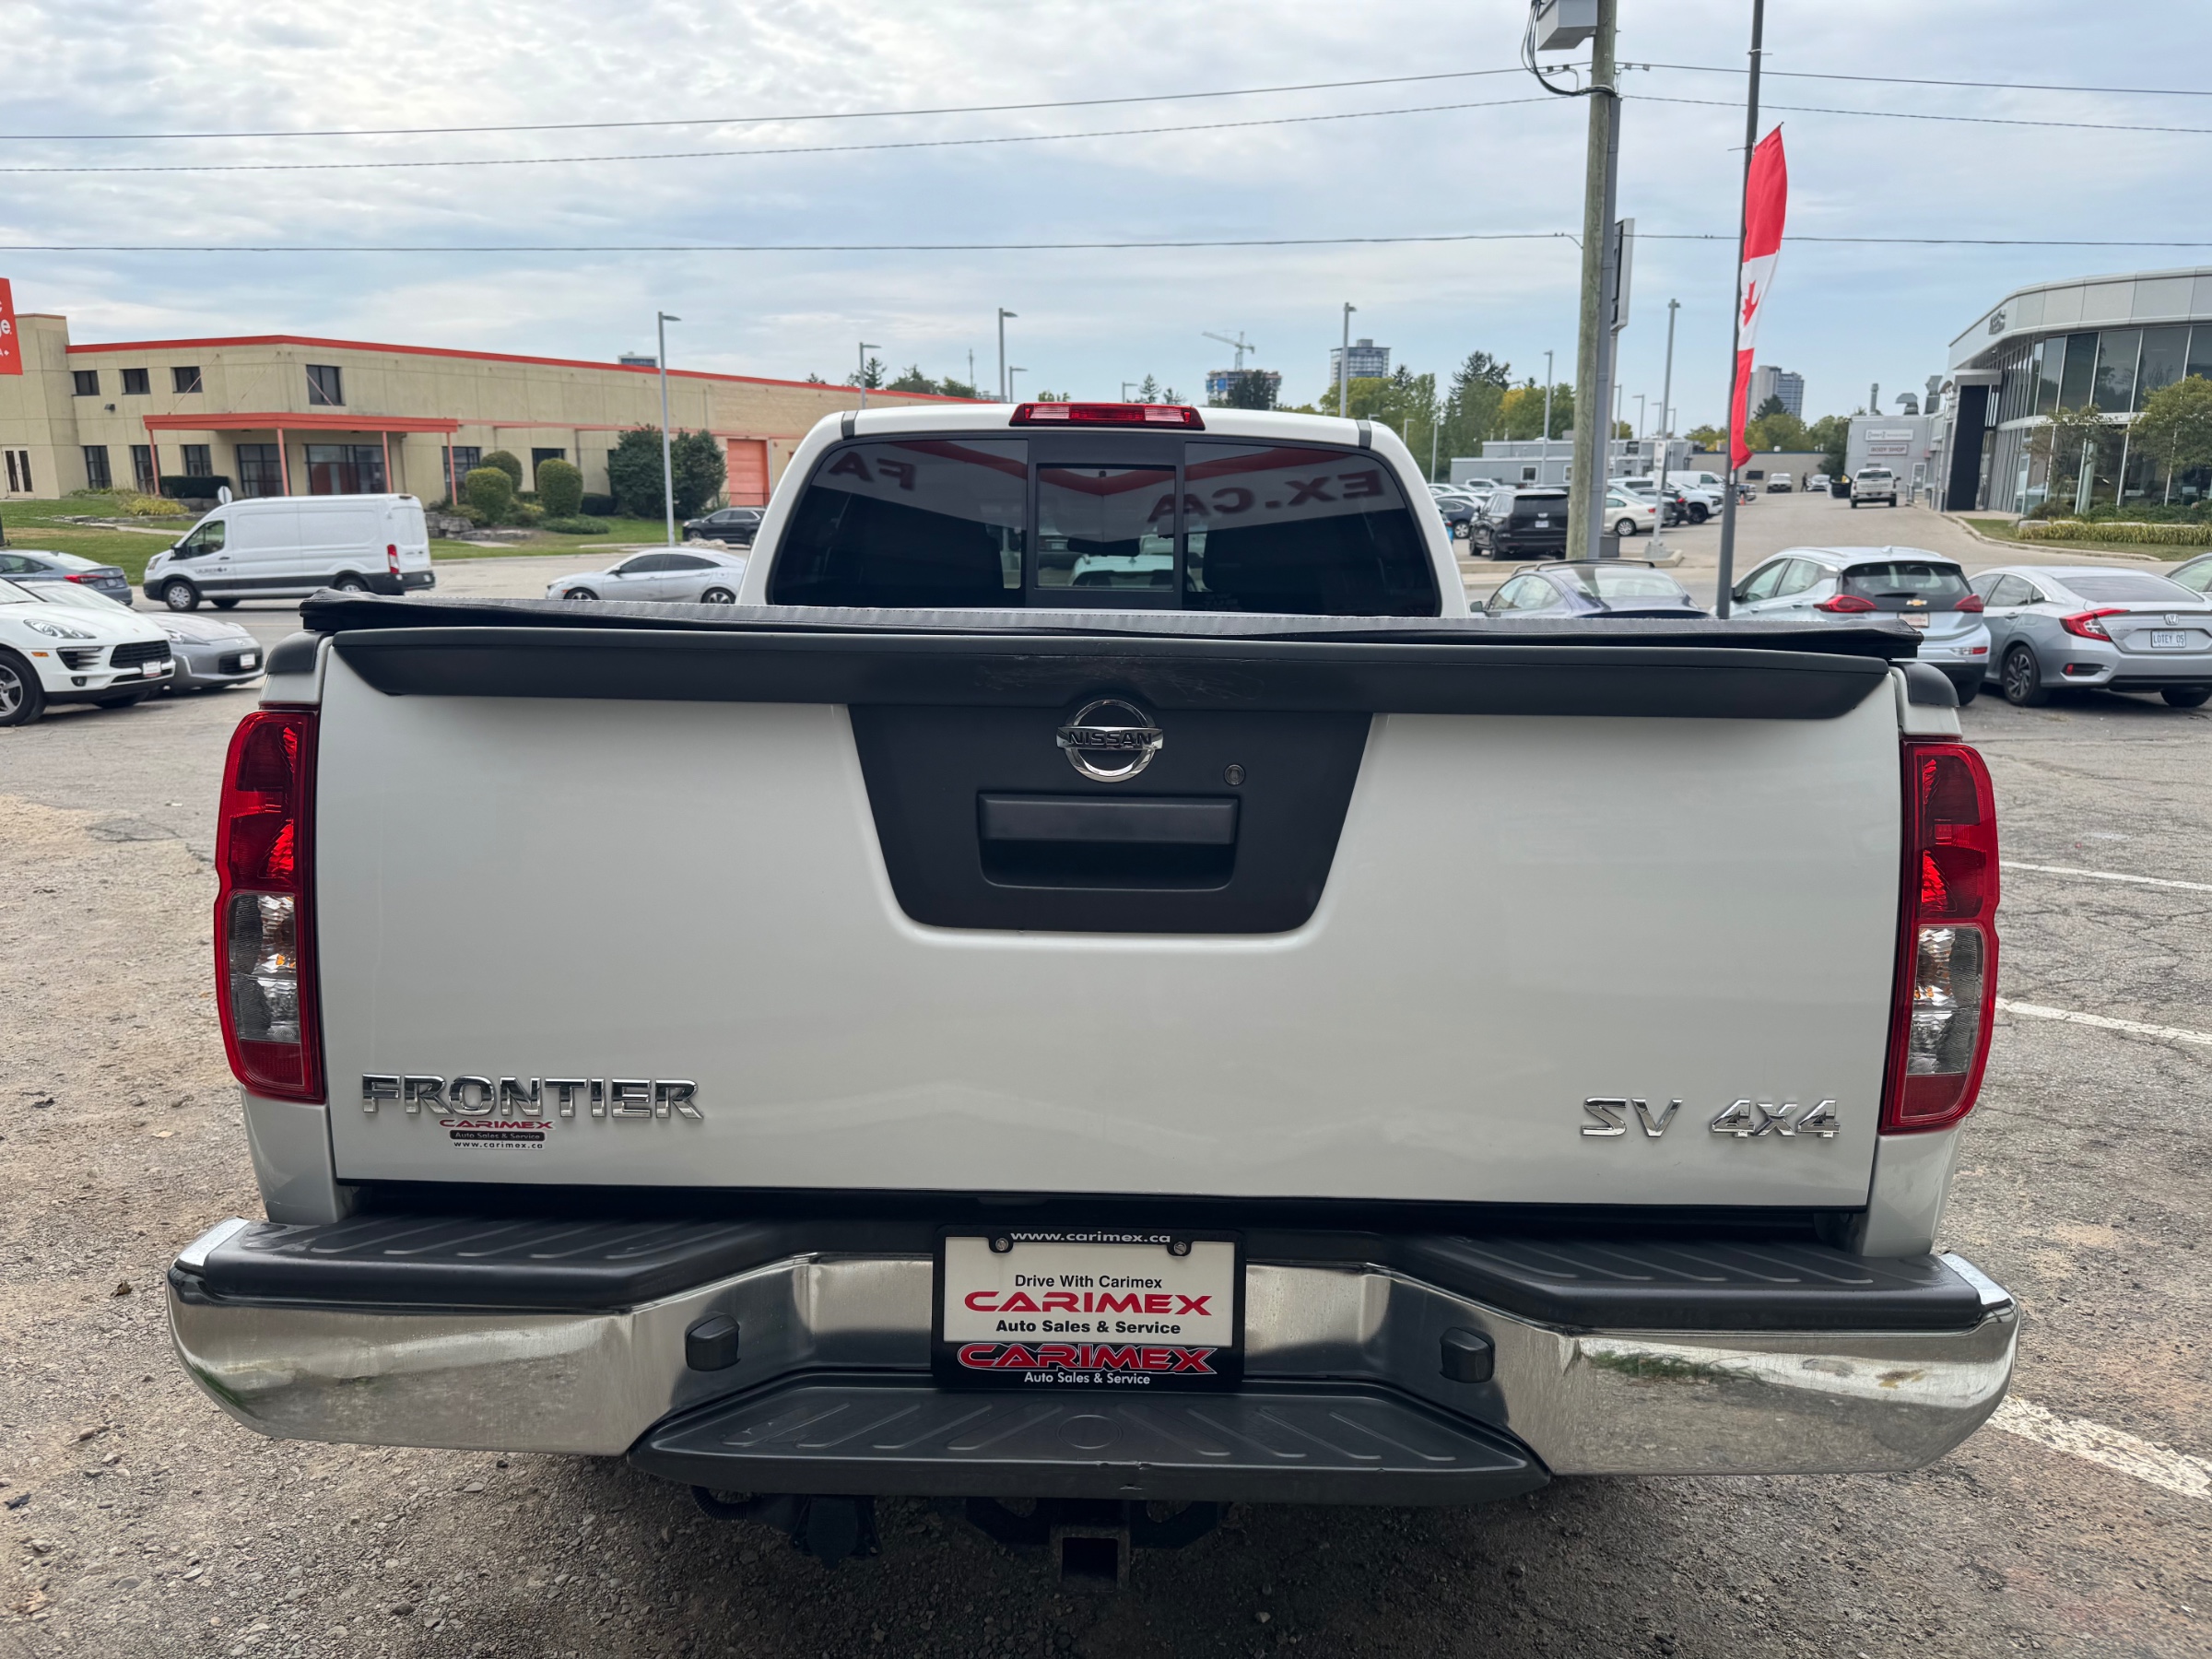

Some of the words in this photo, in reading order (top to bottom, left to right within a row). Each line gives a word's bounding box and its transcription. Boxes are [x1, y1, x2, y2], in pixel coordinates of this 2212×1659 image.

[1068, 731, 1152, 746] NISSAN
[362, 1074, 703, 1119] FRONTIER
[440, 1119, 553, 1129] CARIMEX
[1581, 1097, 1683, 1137] SV
[453, 1141, 543, 1149] www.carimex.ca
[1010, 1231, 1171, 1243] www.carimex.ca
[1015, 1275, 1054, 1287] Drive
[1060, 1275, 1094, 1288] With
[1099, 1276, 1162, 1288] Carimex
[964, 1291, 1212, 1316] CARIMEX
[995, 1320, 1036, 1332] Auto
[1042, 1321, 1090, 1333] Sales
[1097, 1321, 1109, 1333] &
[1115, 1321, 1181, 1334] Service
[958, 1343, 1218, 1373] CARIMEX
[1024, 1372, 1053, 1382] Auto
[1057, 1372, 1089, 1383] Sales
[1094, 1372, 1103, 1383] &
[1107, 1372, 1150, 1384] Service
